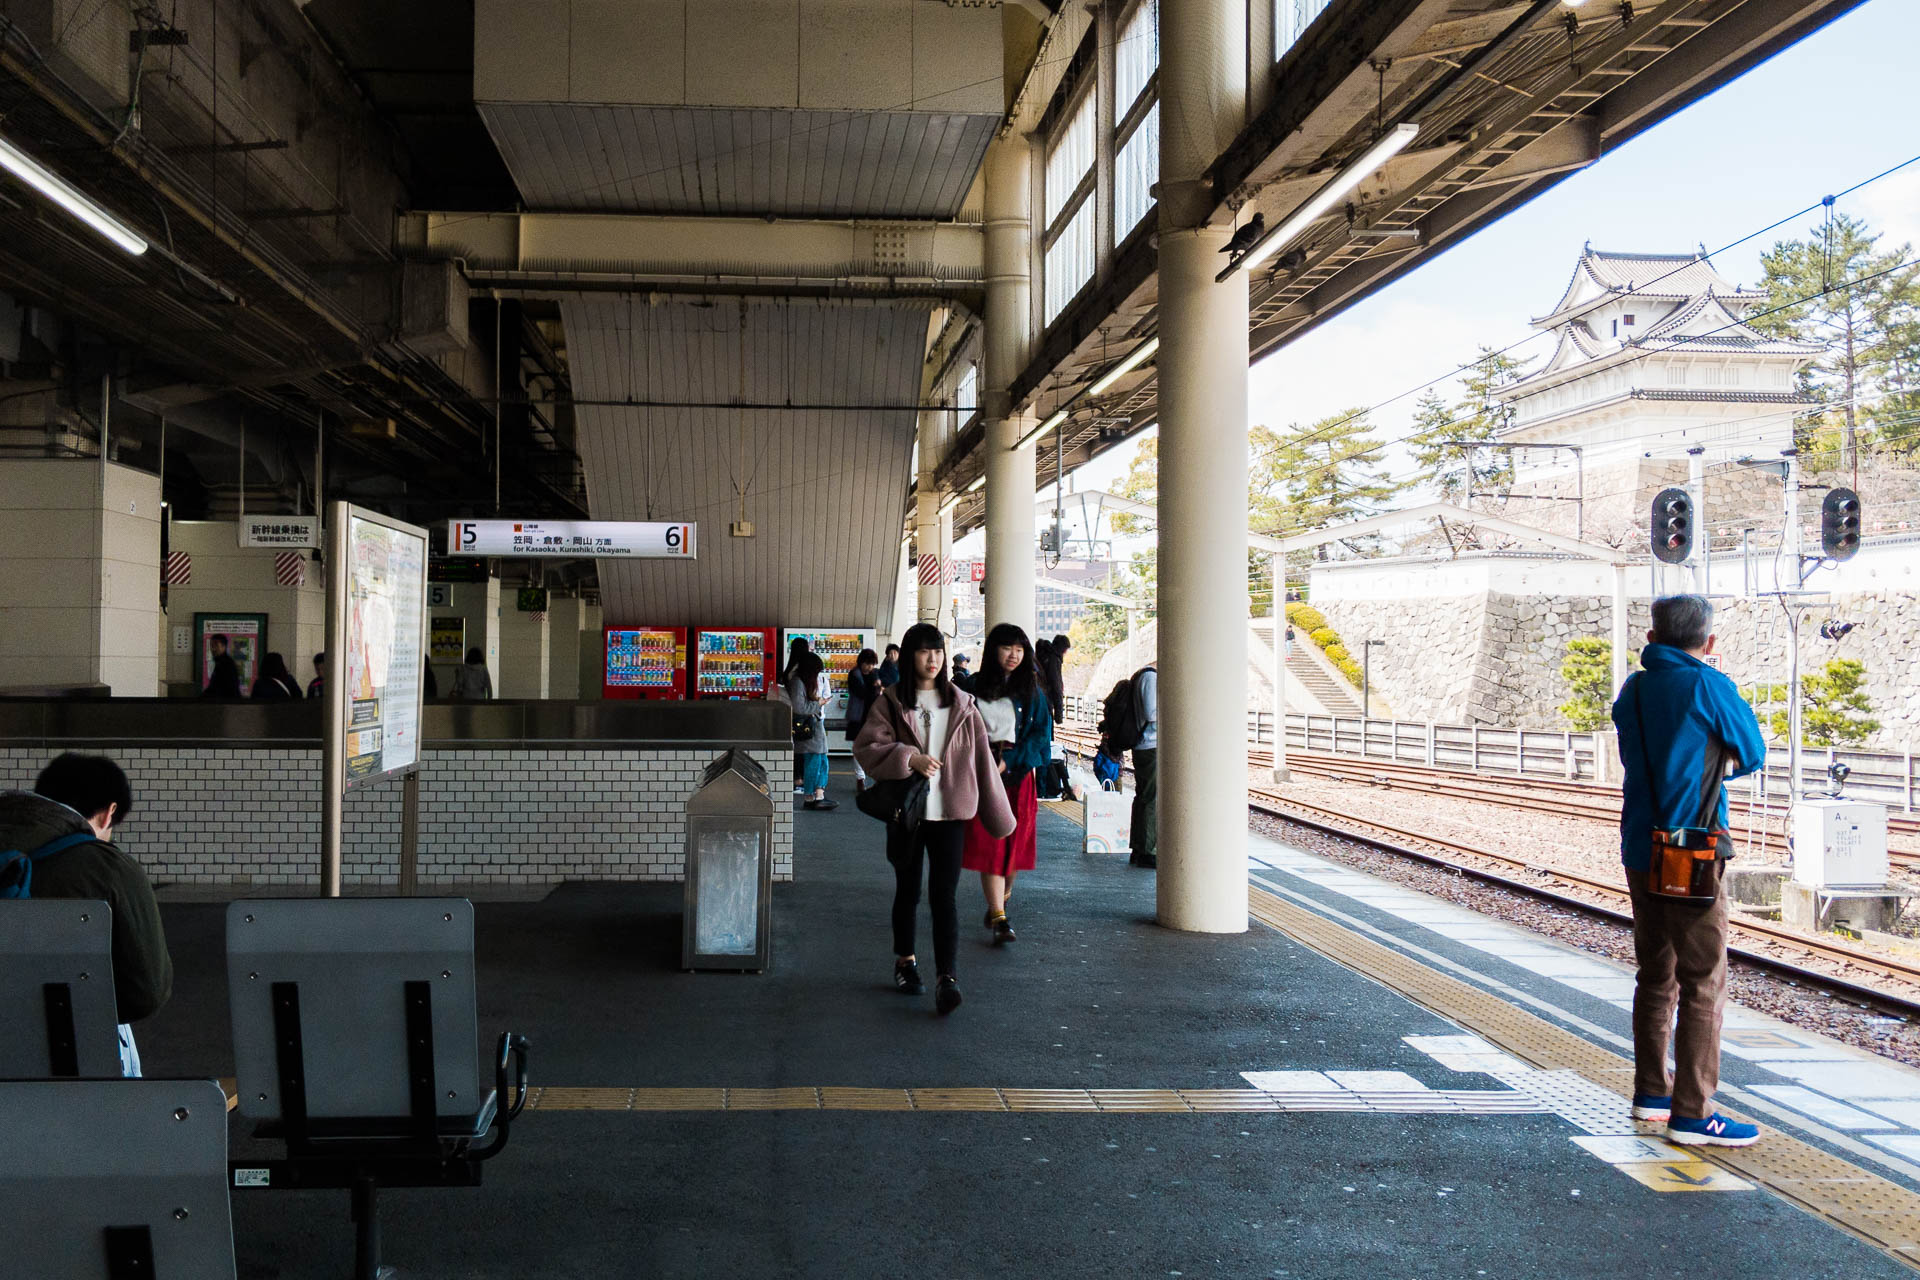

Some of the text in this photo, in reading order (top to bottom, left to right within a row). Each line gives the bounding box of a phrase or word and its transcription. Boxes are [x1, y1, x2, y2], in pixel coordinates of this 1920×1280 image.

[252, 525, 309, 535] 新幹線乗換は
[463, 523, 477, 544] 5
[665, 526, 680, 547] 6
[513, 545, 631, 555] for Kasaoka, Kurashiki, Okayama
[595, 538, 612, 546] 方面
[432, 587, 444, 604] 5
[1706, 1118, 1726, 1135] N
